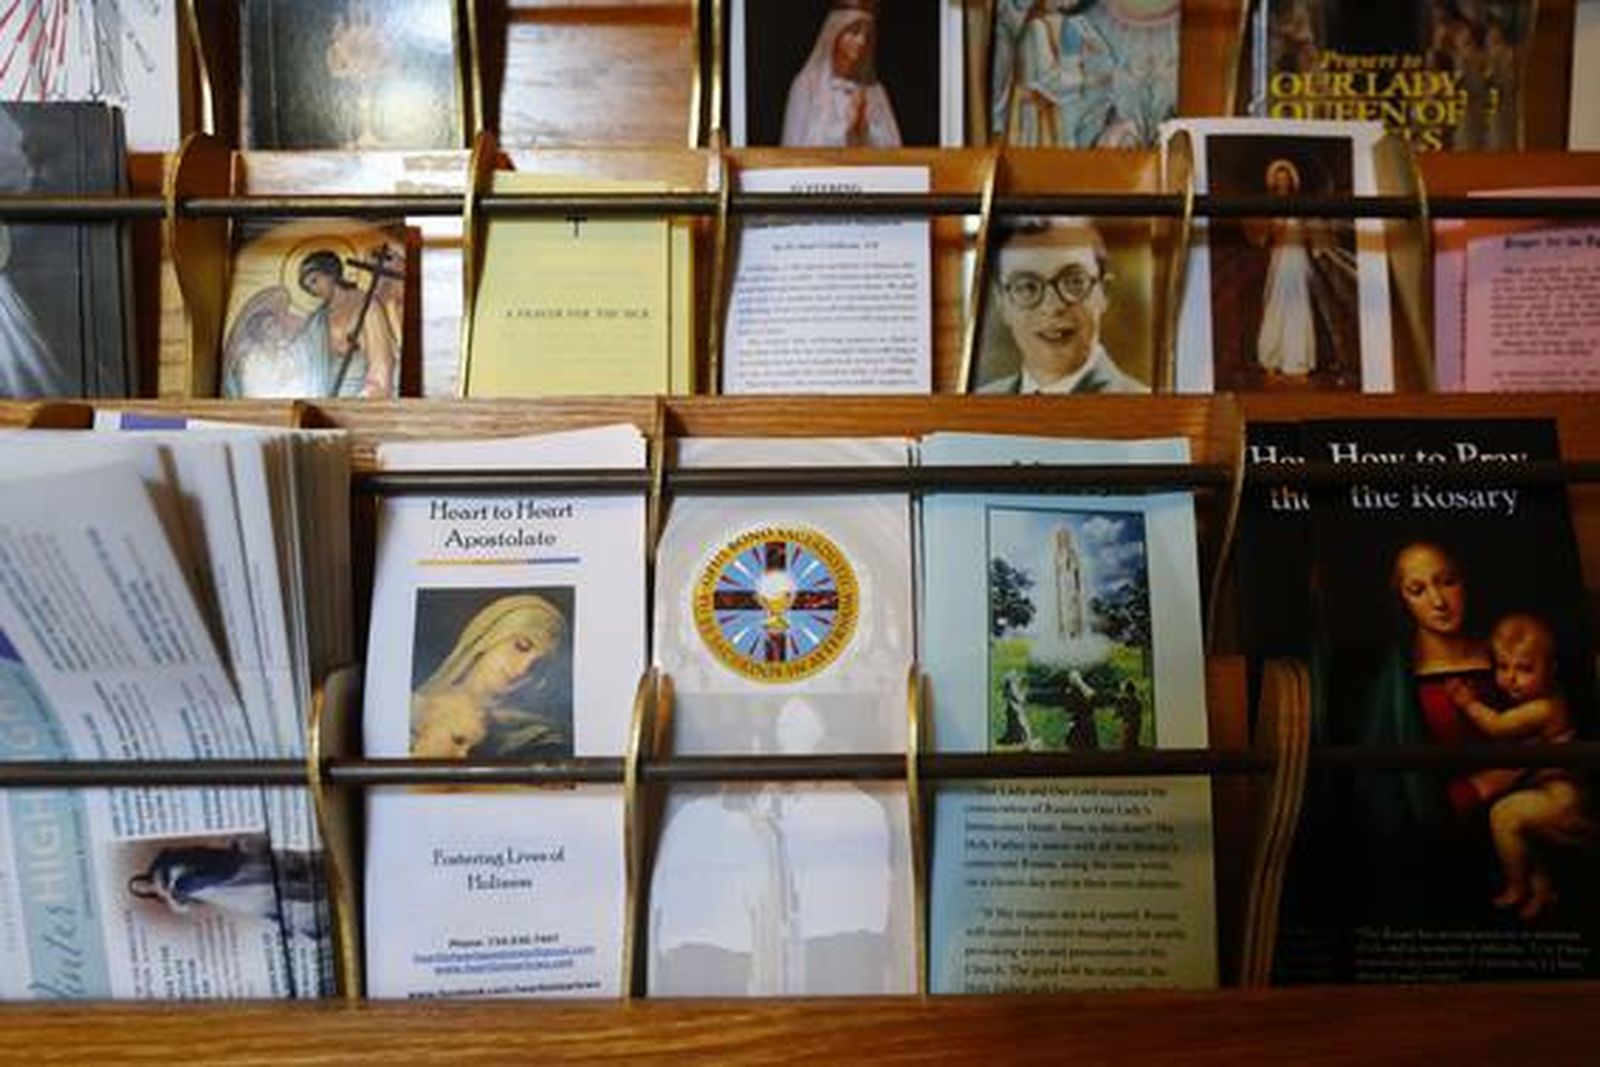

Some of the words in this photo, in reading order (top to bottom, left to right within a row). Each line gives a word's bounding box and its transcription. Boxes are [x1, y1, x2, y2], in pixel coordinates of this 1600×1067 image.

[1319, 50, 1395, 70] Prayers
[1403, 54, 1422, 69] to
[1270, 72, 1356, 98] OUR
[1270, 99, 1406, 124] QUEEN
[1416, 99, 1467, 125] OF
[516, 308, 563, 318] PRAYER
[1328, 442, 1405, 465] How
[1416, 447, 1447, 465] to
[1455, 443, 1529, 465] Pray
[430, 500, 487, 520] Heart
[494, 503, 513, 520] to
[517, 500, 574, 519] Heart
[1352, 484, 1402, 509] the
[1410, 485, 1519, 515] Rosary
[445, 528, 557, 549] Apostolate
[433, 847, 505, 868] Fostering
[507, 846, 547, 865] Lives
[550, 846, 566, 862] of
[467, 873, 533, 892] Holiness
